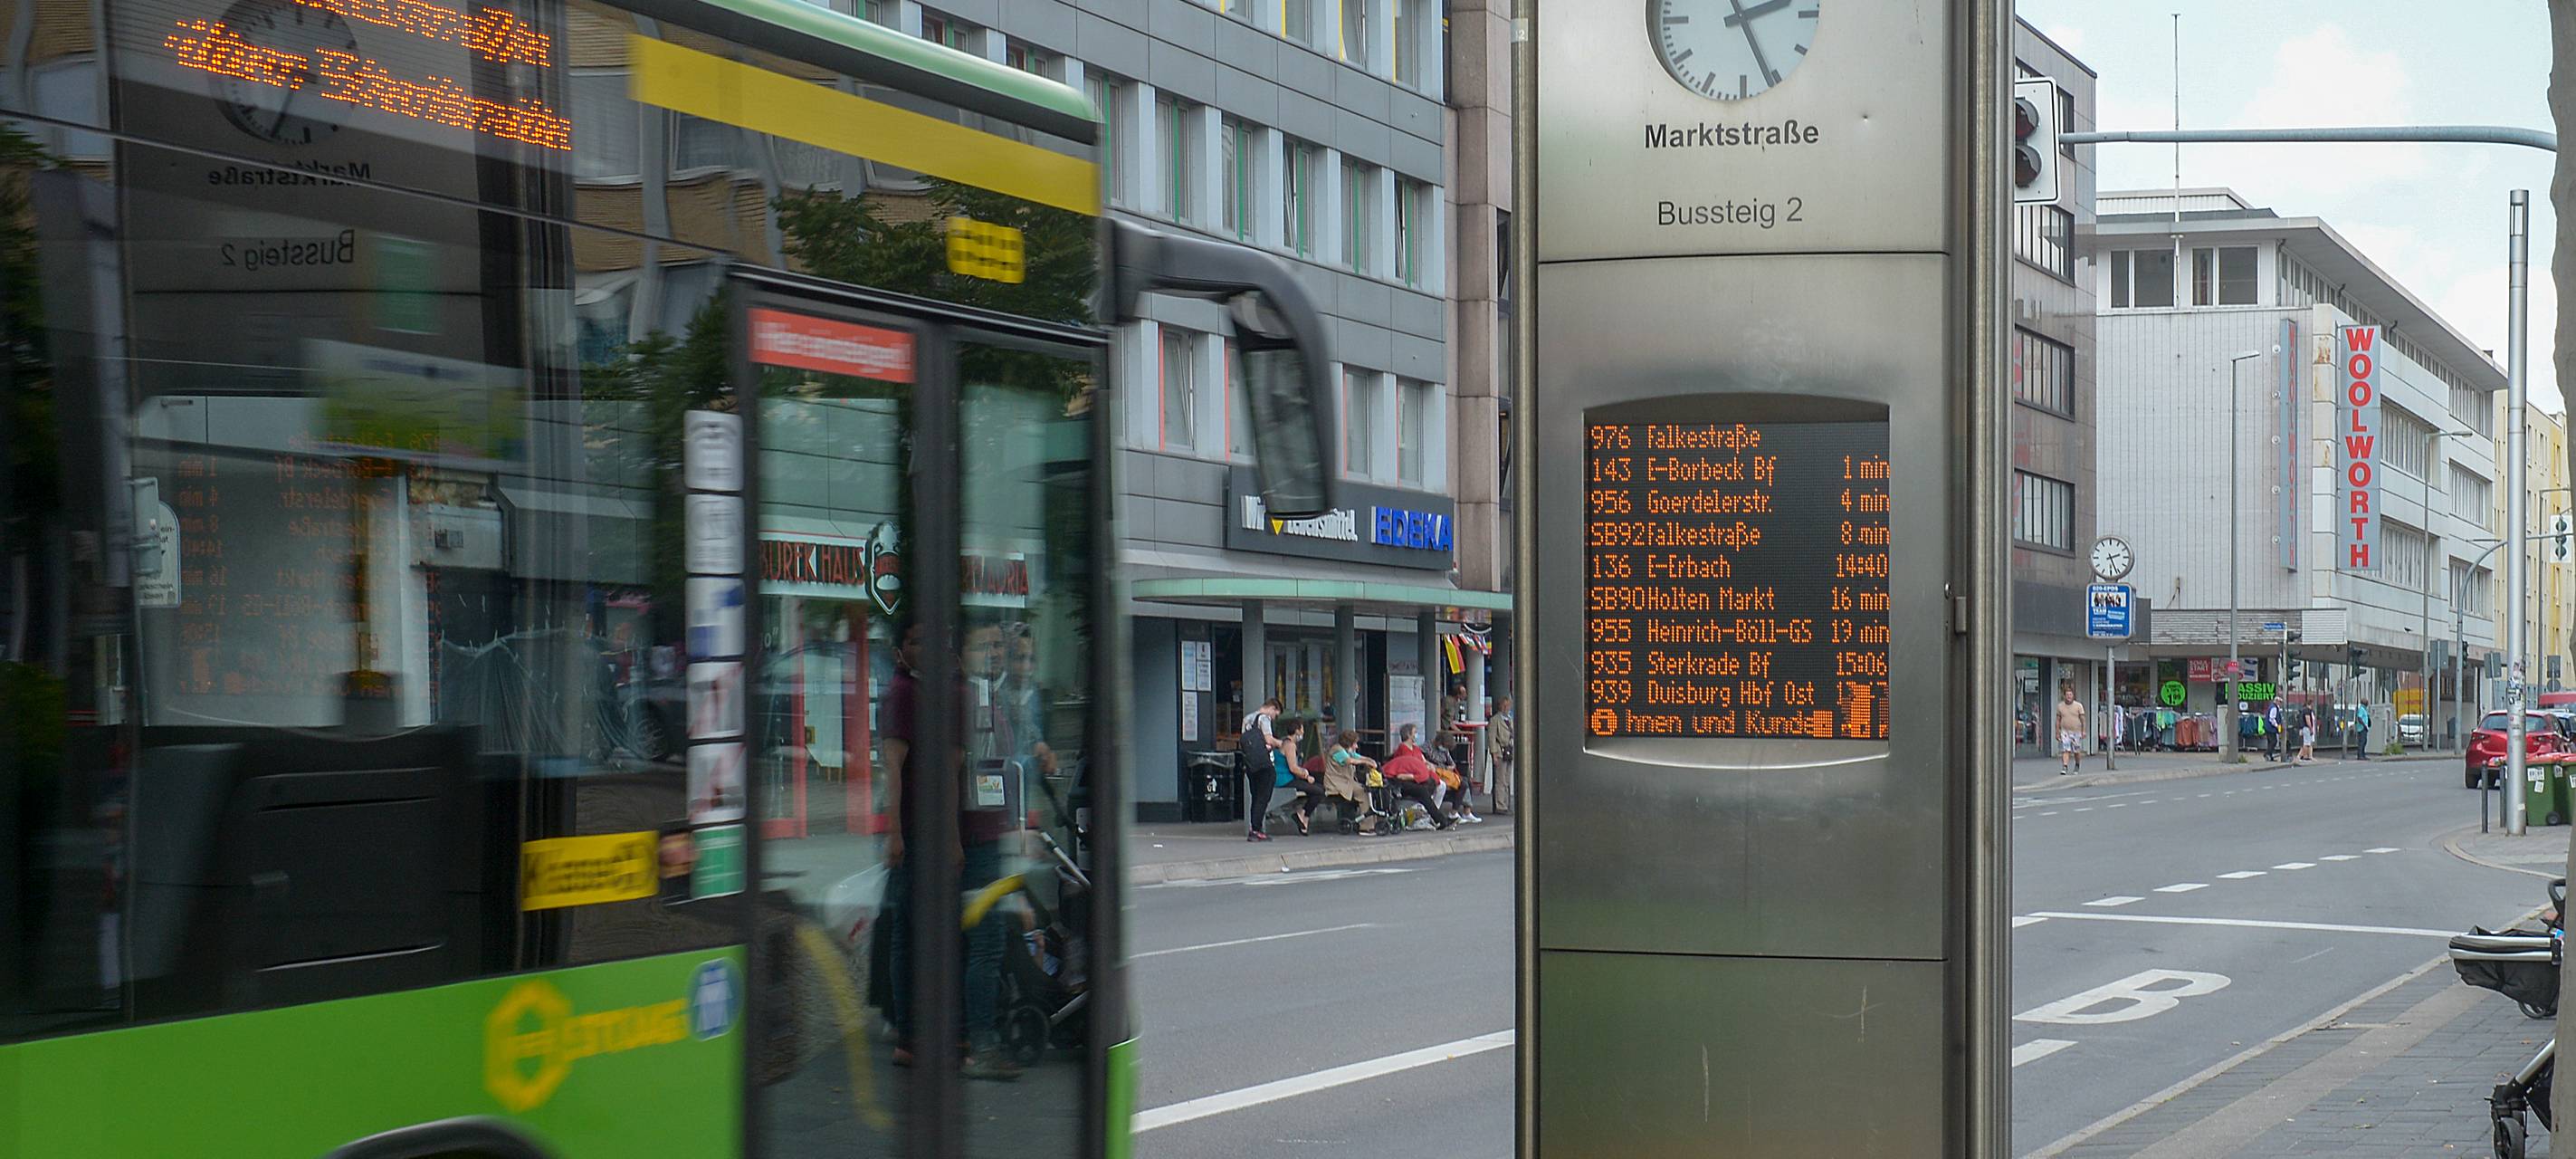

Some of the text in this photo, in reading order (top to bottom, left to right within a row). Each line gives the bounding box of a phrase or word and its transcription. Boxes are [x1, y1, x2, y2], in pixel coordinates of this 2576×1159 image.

[1644, 120, 1819, 149] Marktstraße
[1658, 196, 1803, 229] Bussteig 2
[1590, 423, 1761, 454] 976 Falkestraße
[2345, 327, 2374, 569] WOOLWORTH
[1592, 455, 1891, 486] 143 E-Borbeck Bf 1 min
[1590, 488, 1891, 513] 956 Goerdelerstr. 4 min
[1370, 506, 1454, 551] EDEKA
[1590, 521, 1891, 552] SB92 Falkestraße 8 min
[821, 543, 865, 585] HAUS
[1592, 553, 1888, 579] 136 E-Erbach 14:40
[1647, 586, 1710, 611] Holten
[1719, 586, 1775, 611] Markt
[1831, 586, 1853, 611] 16
[1859, 586, 1891, 611] min
[1590, 618, 1891, 644] 955 Heinrich-Böll-GS 19 min
[1590, 651, 1888, 679] 935 Sterkrade Bf 15:06
[1590, 679, 1631, 704] 939
[1647, 680, 1732, 708] Duisburg
[1740, 680, 1775, 708] Hbf
[1784, 680, 1815, 704] Ost
[2225, 683, 2275, 693] ASSIV
[1692, 709, 1736, 734] und
